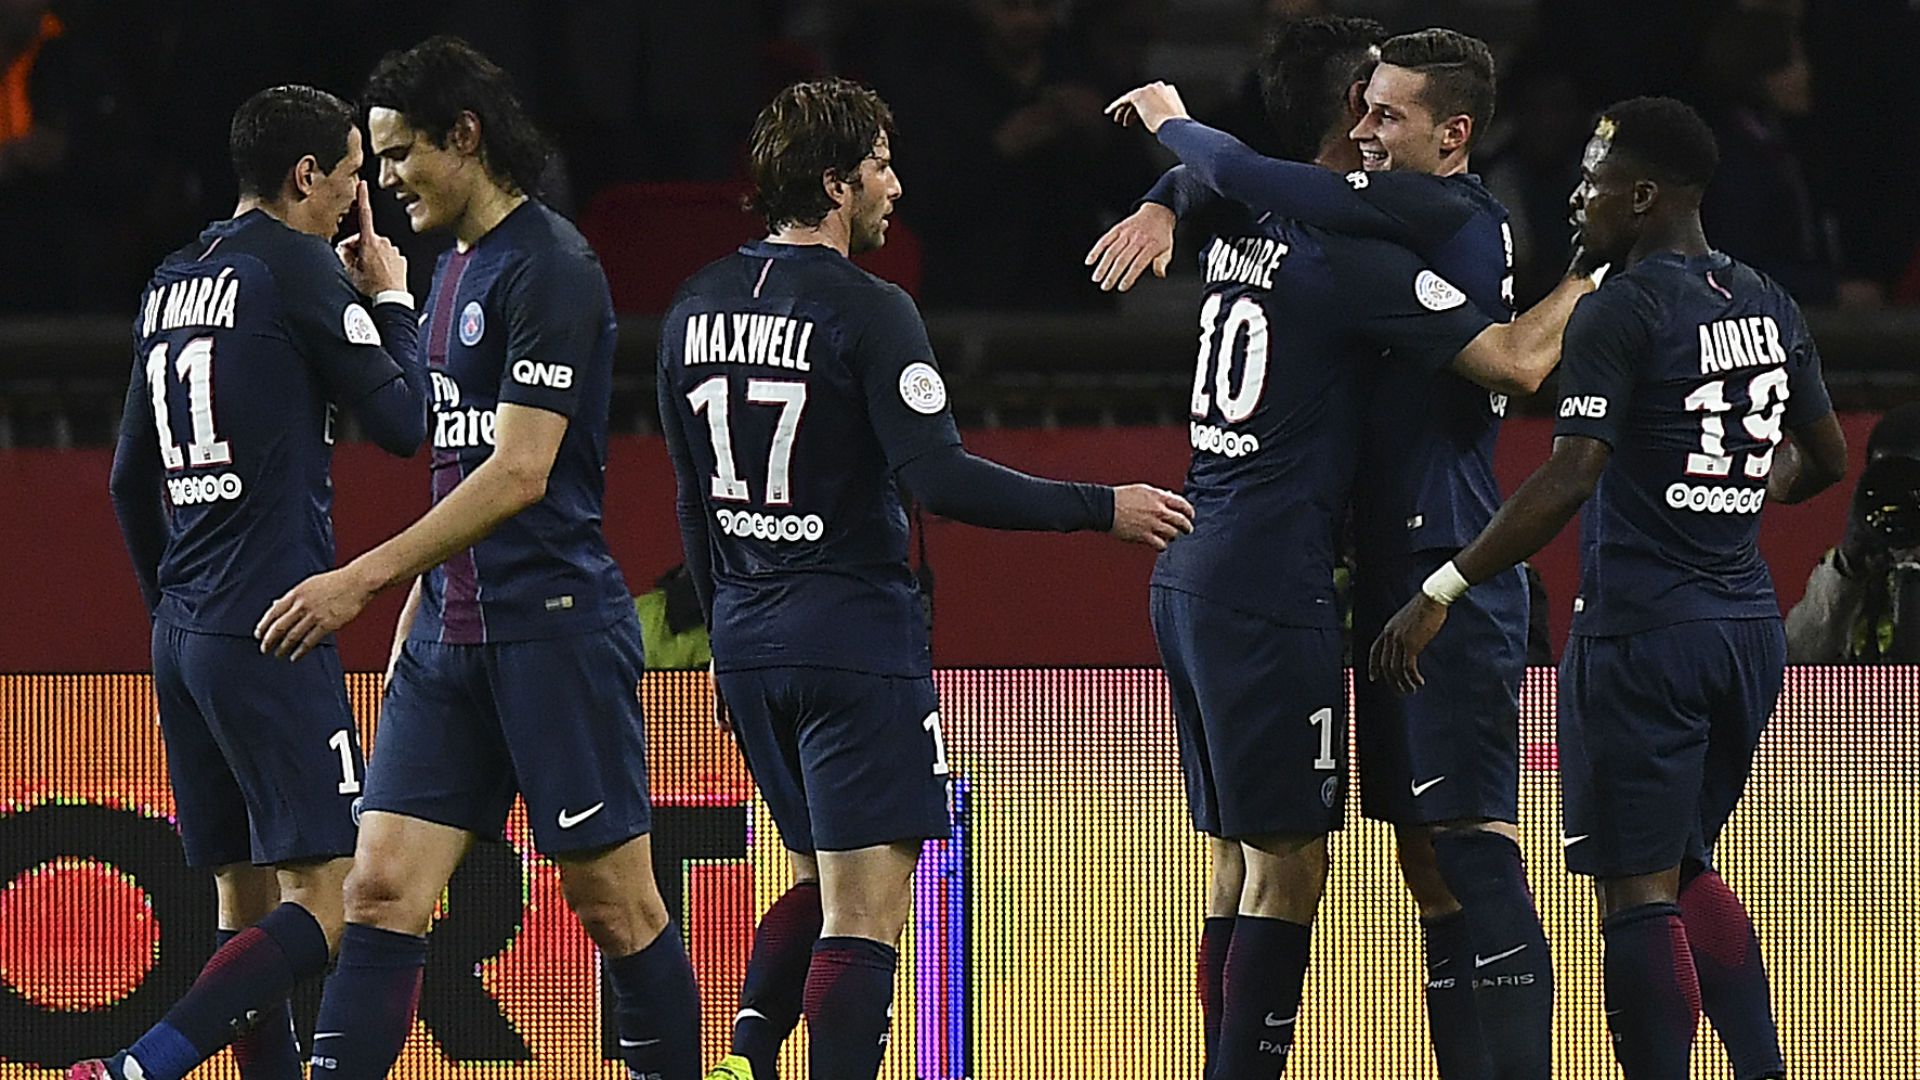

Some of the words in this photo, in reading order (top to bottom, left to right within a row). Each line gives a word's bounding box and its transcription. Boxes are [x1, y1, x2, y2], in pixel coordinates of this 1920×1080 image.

[161, 267, 239, 330] MARÍA
[684, 313, 814, 372] MAXWELL
[1191, 293, 1269, 423] 10
[1699, 316, 1787, 375] AURIER
[146, 336, 233, 471] 11
[512, 359, 573, 389] QNB
[1559, 396, 1608, 419] QNB
[1684, 366, 1790, 479] 19
[686, 375, 807, 504] 17
[716, 508, 824, 541] ooredoo
[329, 729, 361, 794] 1
[1472, 973, 1535, 991] PARIS
